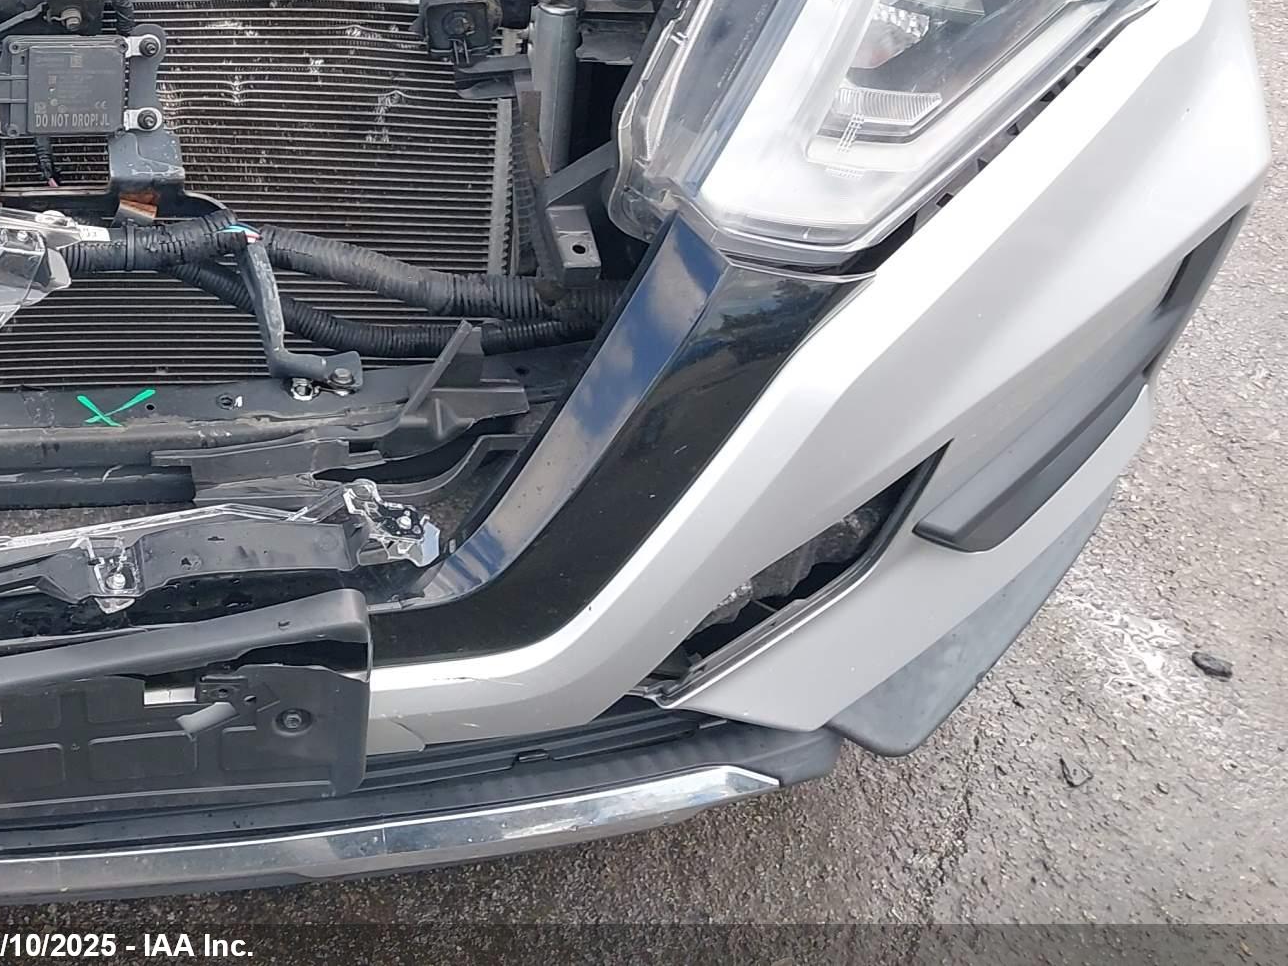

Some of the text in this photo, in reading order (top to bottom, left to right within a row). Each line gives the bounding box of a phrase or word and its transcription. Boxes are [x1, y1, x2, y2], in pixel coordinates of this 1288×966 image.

[35, 114, 48, 127] DO
[51, 113, 70, 127] NOT
[72, 113, 99, 126] DROP!
